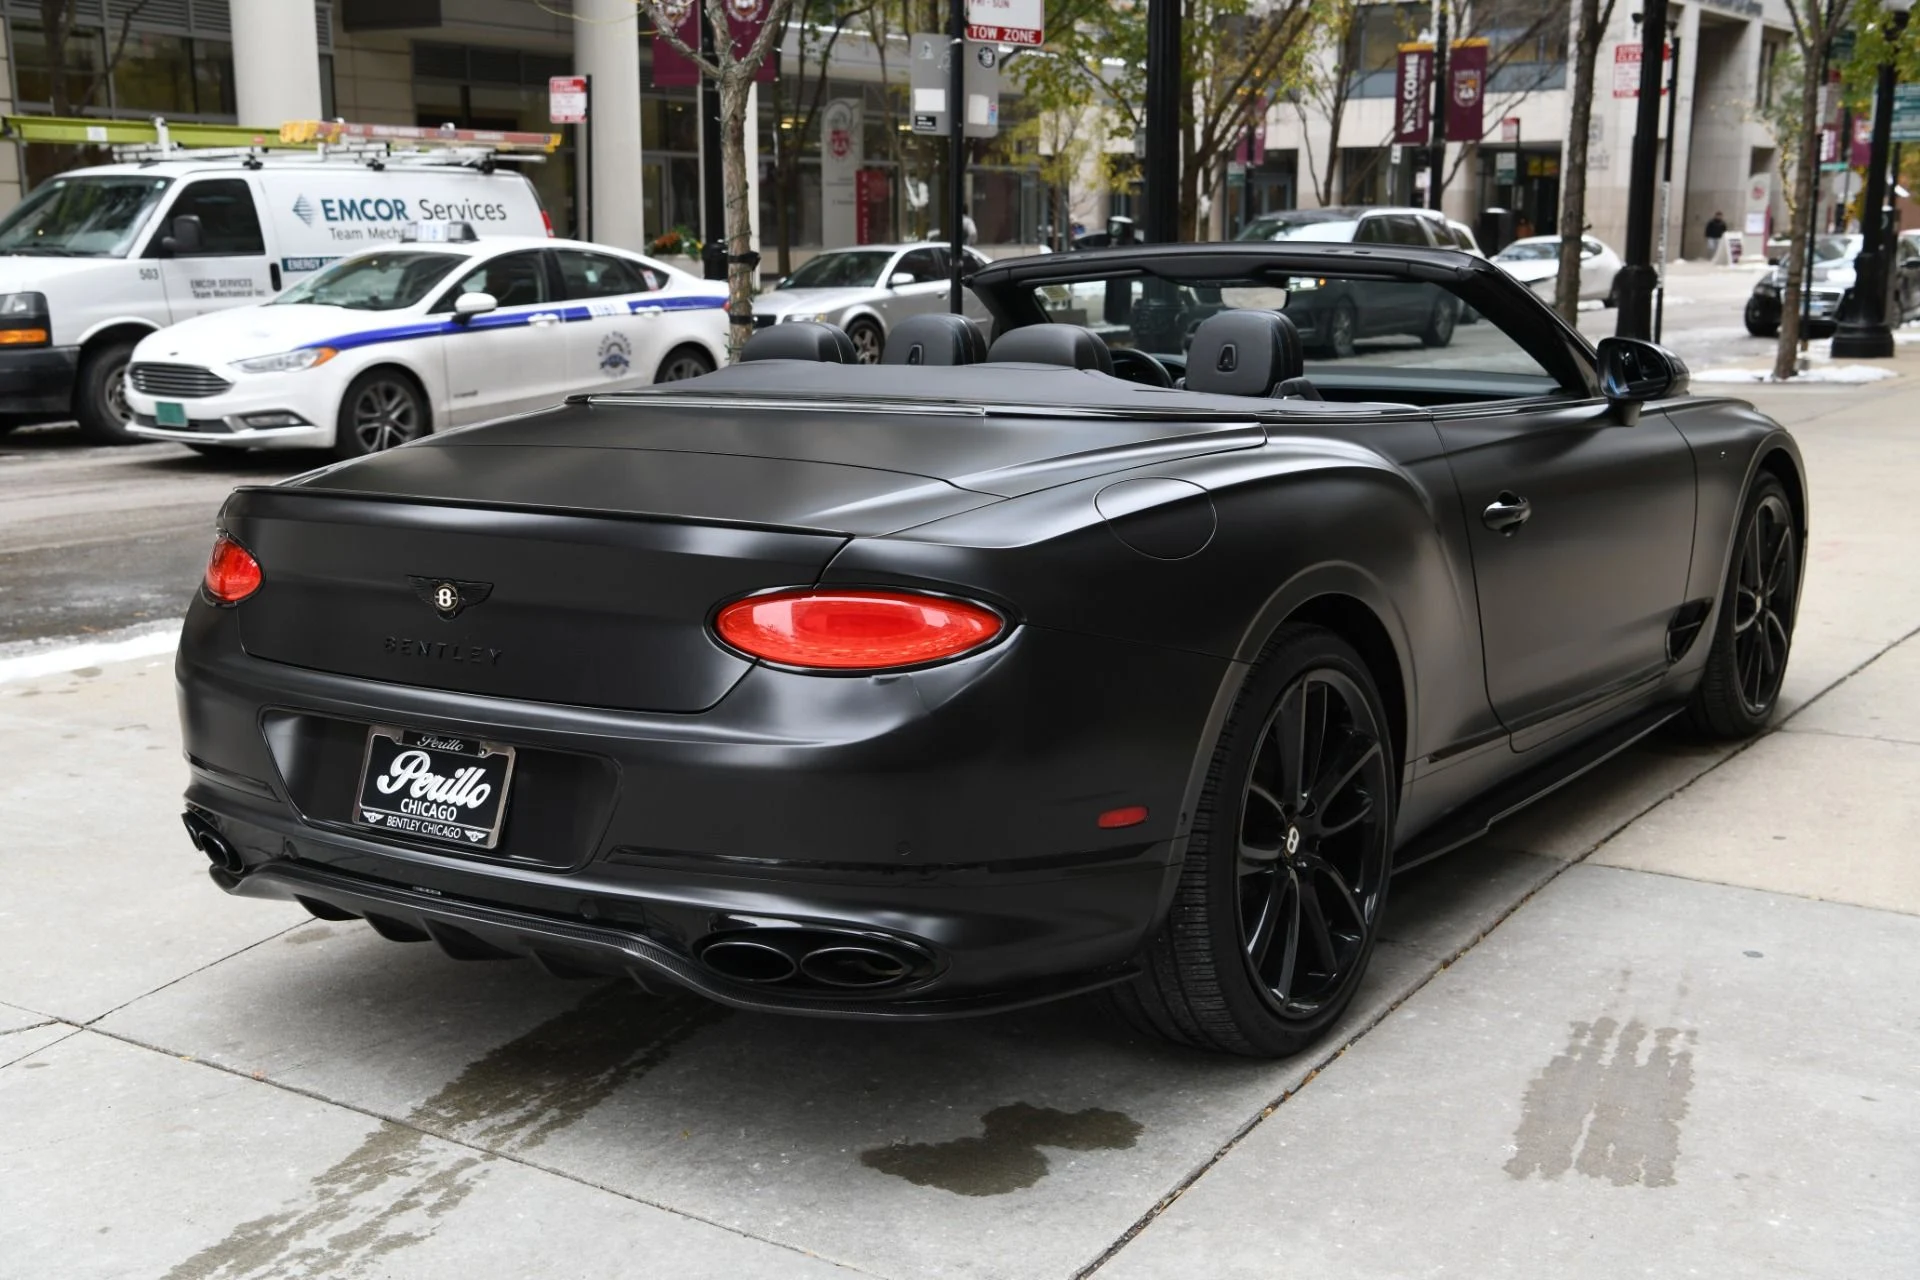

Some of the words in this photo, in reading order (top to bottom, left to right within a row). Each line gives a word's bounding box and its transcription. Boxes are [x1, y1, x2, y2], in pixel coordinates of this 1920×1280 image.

[971, 26, 998, 39] TOW
[1003, 28, 1036, 43] ZONE
[320, 198, 410, 221] EMCOR
[419, 198, 507, 221] Services
[329, 227, 363, 240] Team
[287, 259, 321, 271] ENERGY
[139, 267, 159, 281] 503
[218, 278, 253, 289] SERVICES
[385, 635, 502, 665] BENTLEY
[417, 735, 464, 751] Perillo
[376, 750, 491, 809] Perillo
[400, 798, 457, 821] CHICAGO
[387, 815, 421, 831] BENTLEY
[421, 822, 461, 839] CHICAGO
